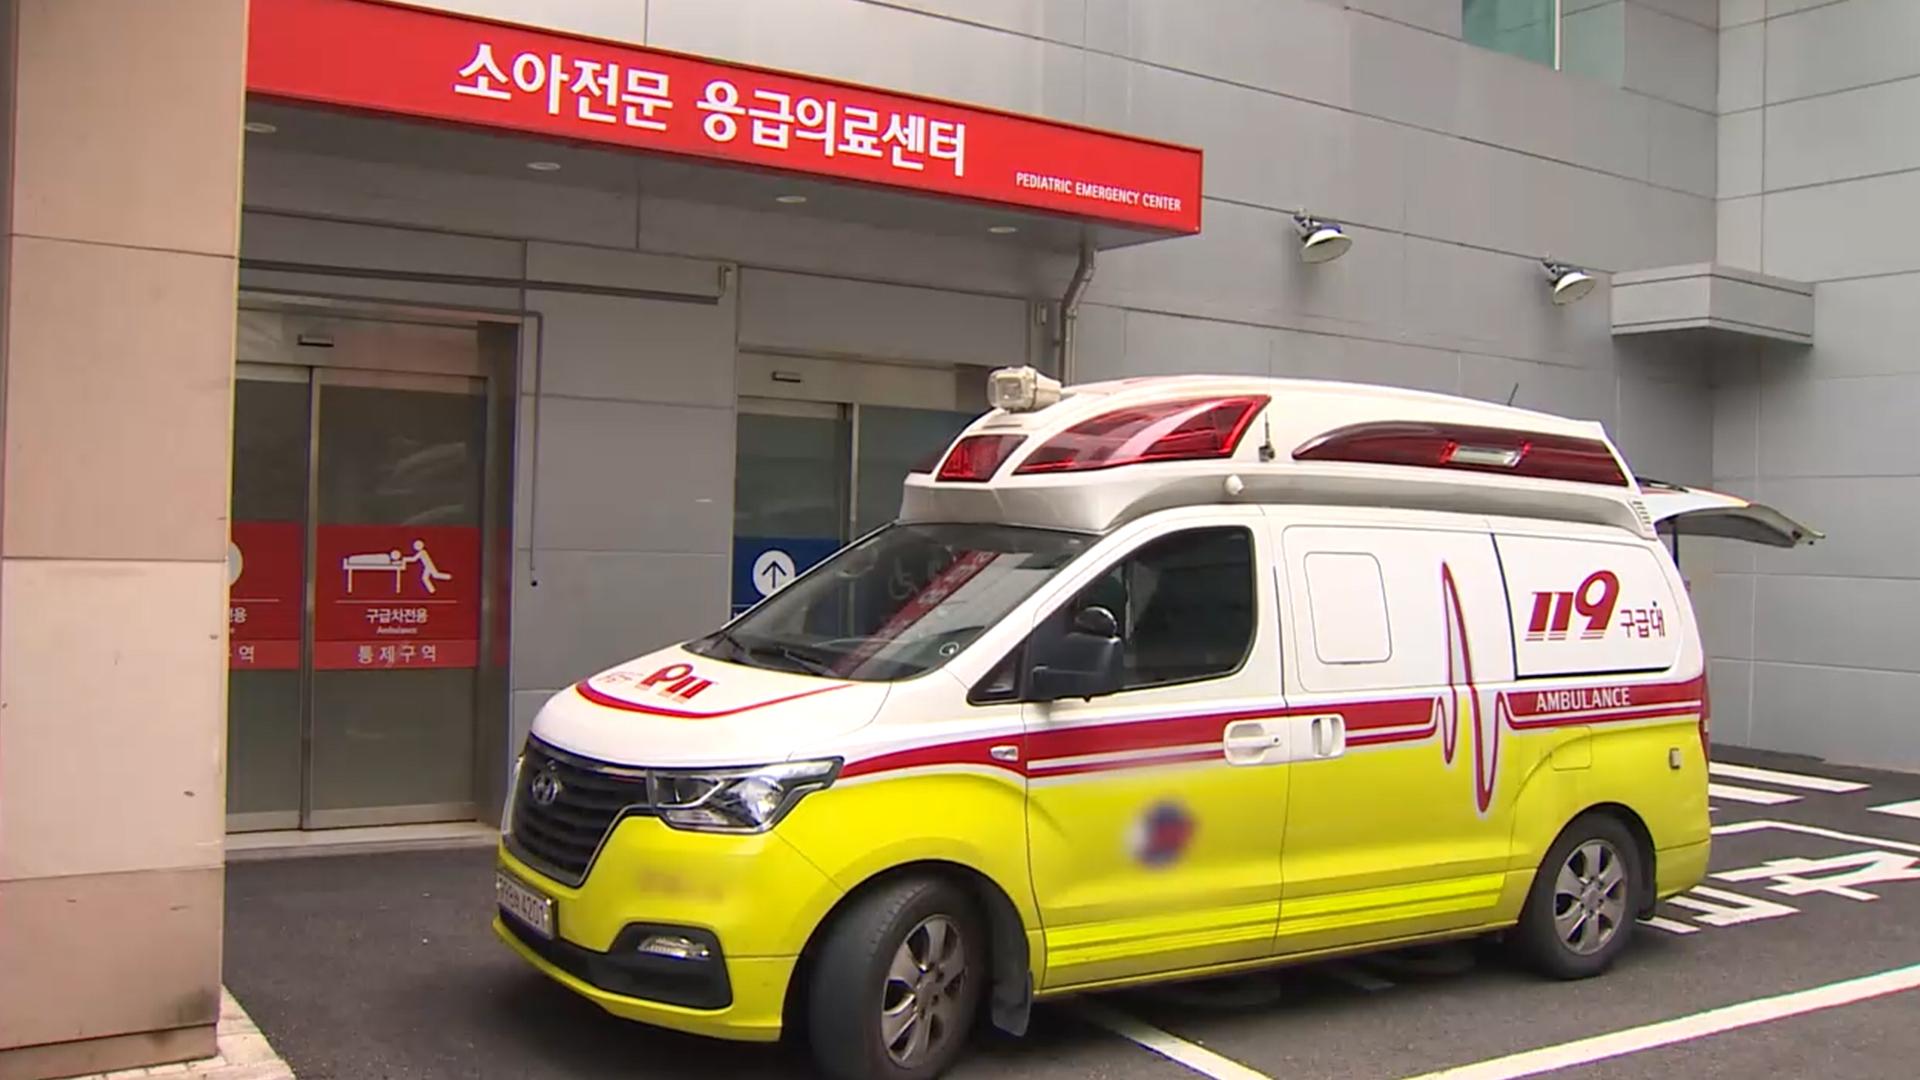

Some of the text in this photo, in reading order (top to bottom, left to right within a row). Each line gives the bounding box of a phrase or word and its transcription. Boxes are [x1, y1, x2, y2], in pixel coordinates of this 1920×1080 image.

[454, 42, 967, 177] 소아전문 응급의료센터
[1016, 171, 1181, 212] PEDIATRIC EMERGENCY CENTER
[366, 607, 428, 624] 구급차전용
[1525, 570, 1665, 641] 119 구급대
[1536, 687, 1631, 711] AMBULANCE
